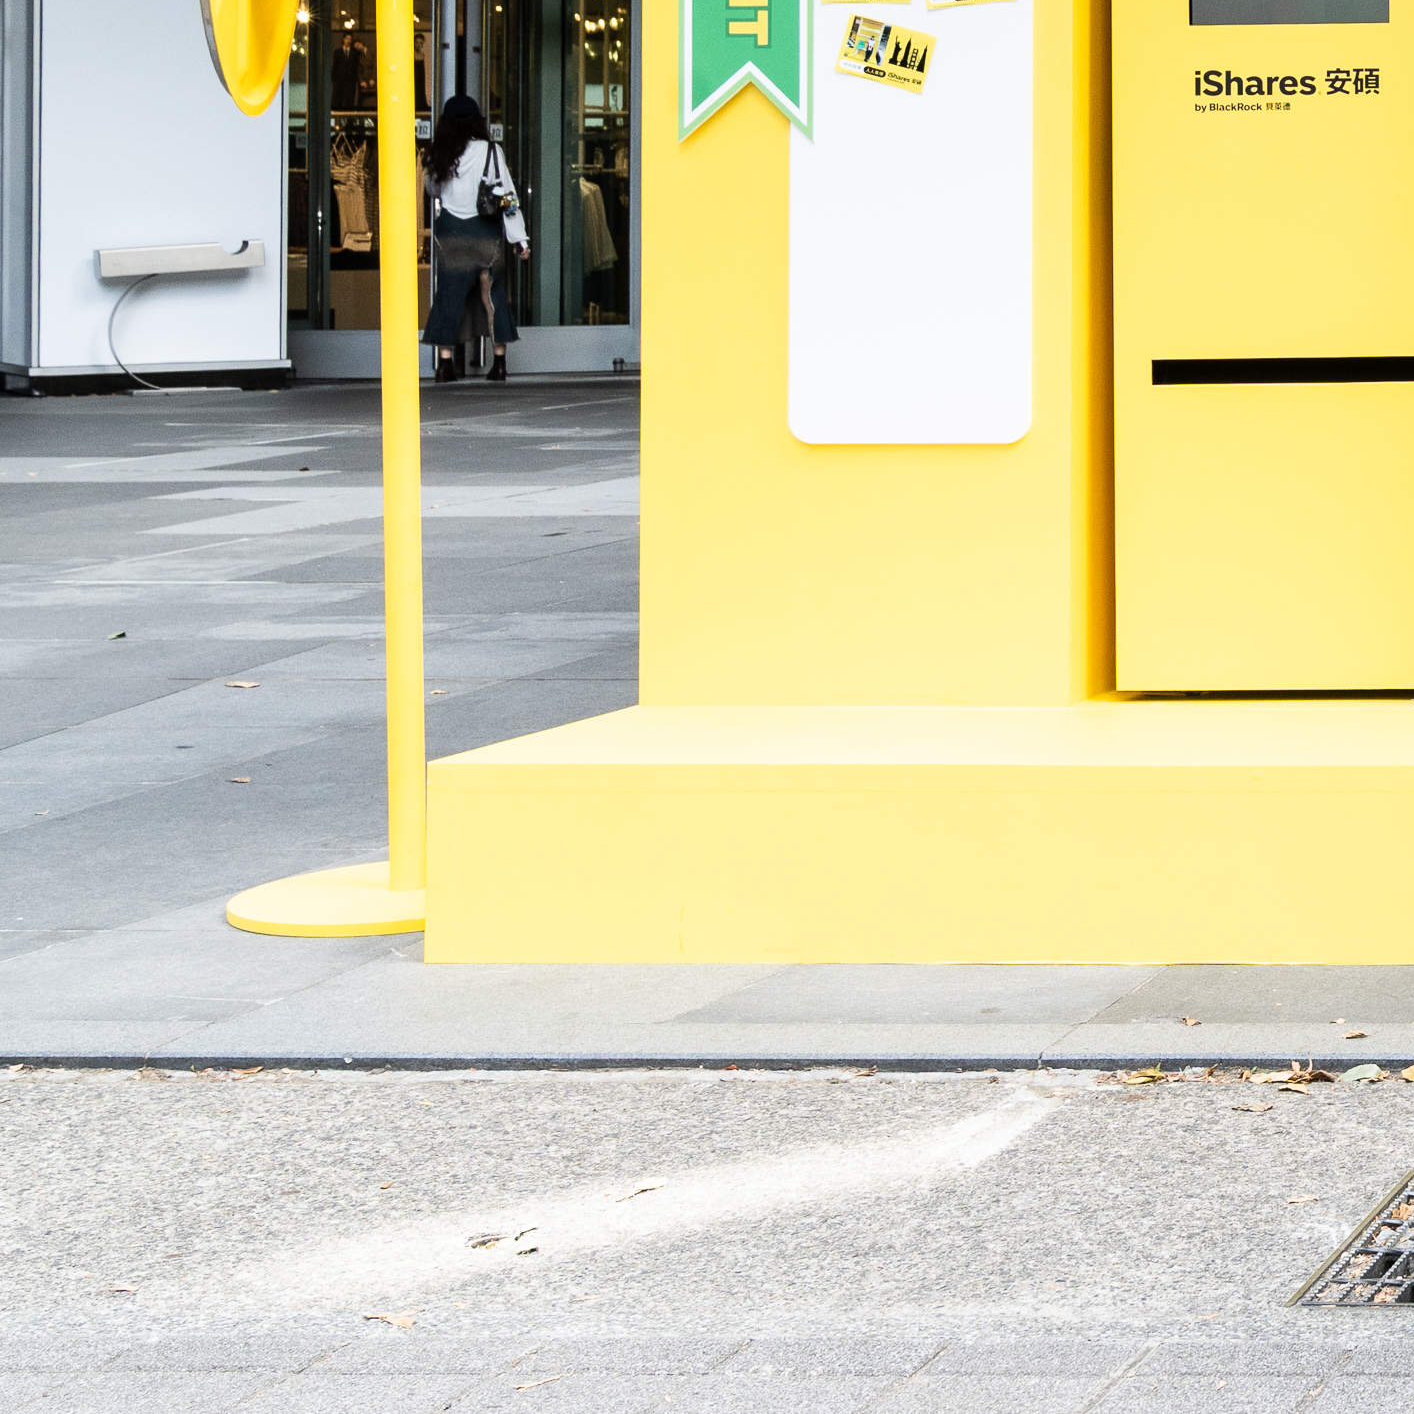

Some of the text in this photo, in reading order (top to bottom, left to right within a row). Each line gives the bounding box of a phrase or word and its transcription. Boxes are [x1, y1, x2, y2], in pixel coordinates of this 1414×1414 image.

[887, 71, 911, 84] iShares
[1194, 67, 1380, 97] iShares 安碩
[1194, 102, 1207, 114] by
[1209, 102, 1263, 112] BlackRock
